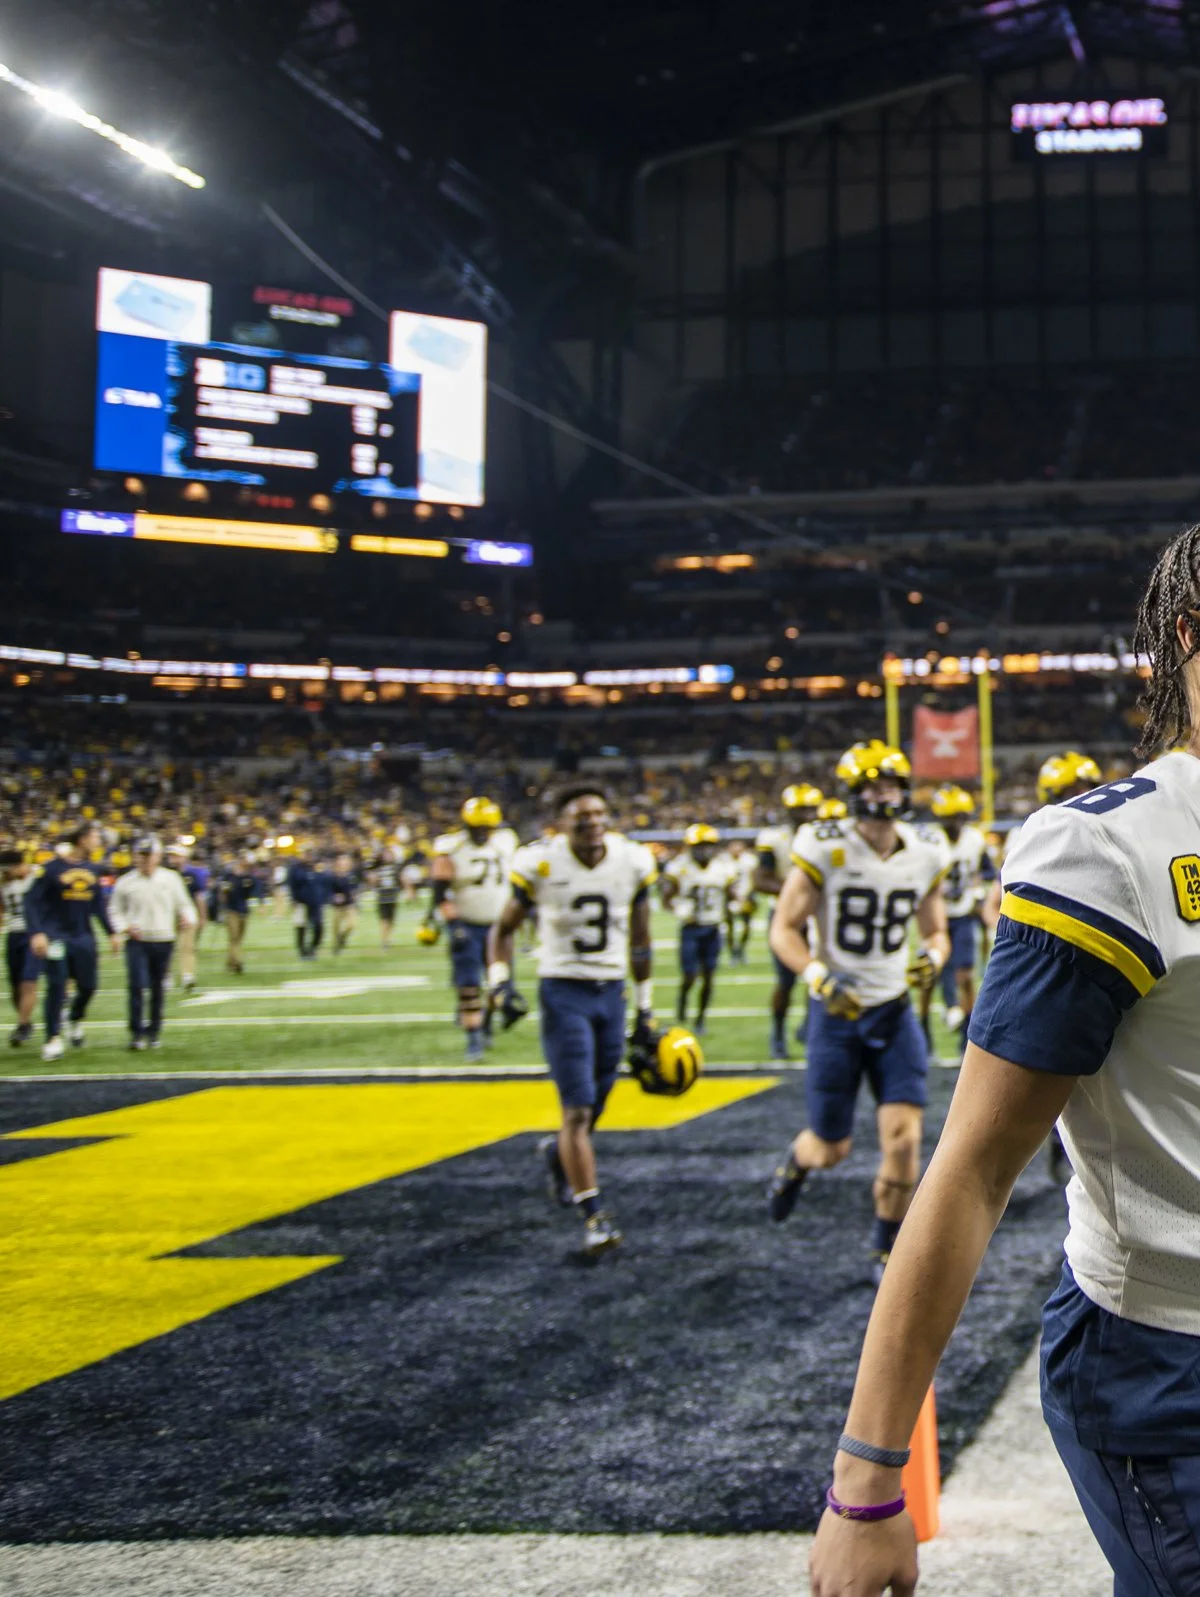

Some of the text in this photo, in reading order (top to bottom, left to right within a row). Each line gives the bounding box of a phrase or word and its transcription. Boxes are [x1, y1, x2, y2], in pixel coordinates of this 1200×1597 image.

[1062, 777, 1157, 815] 8
[1181, 863, 1200, 880] TM
[571, 894, 609, 953] 3
[837, 887, 917, 955] 88
